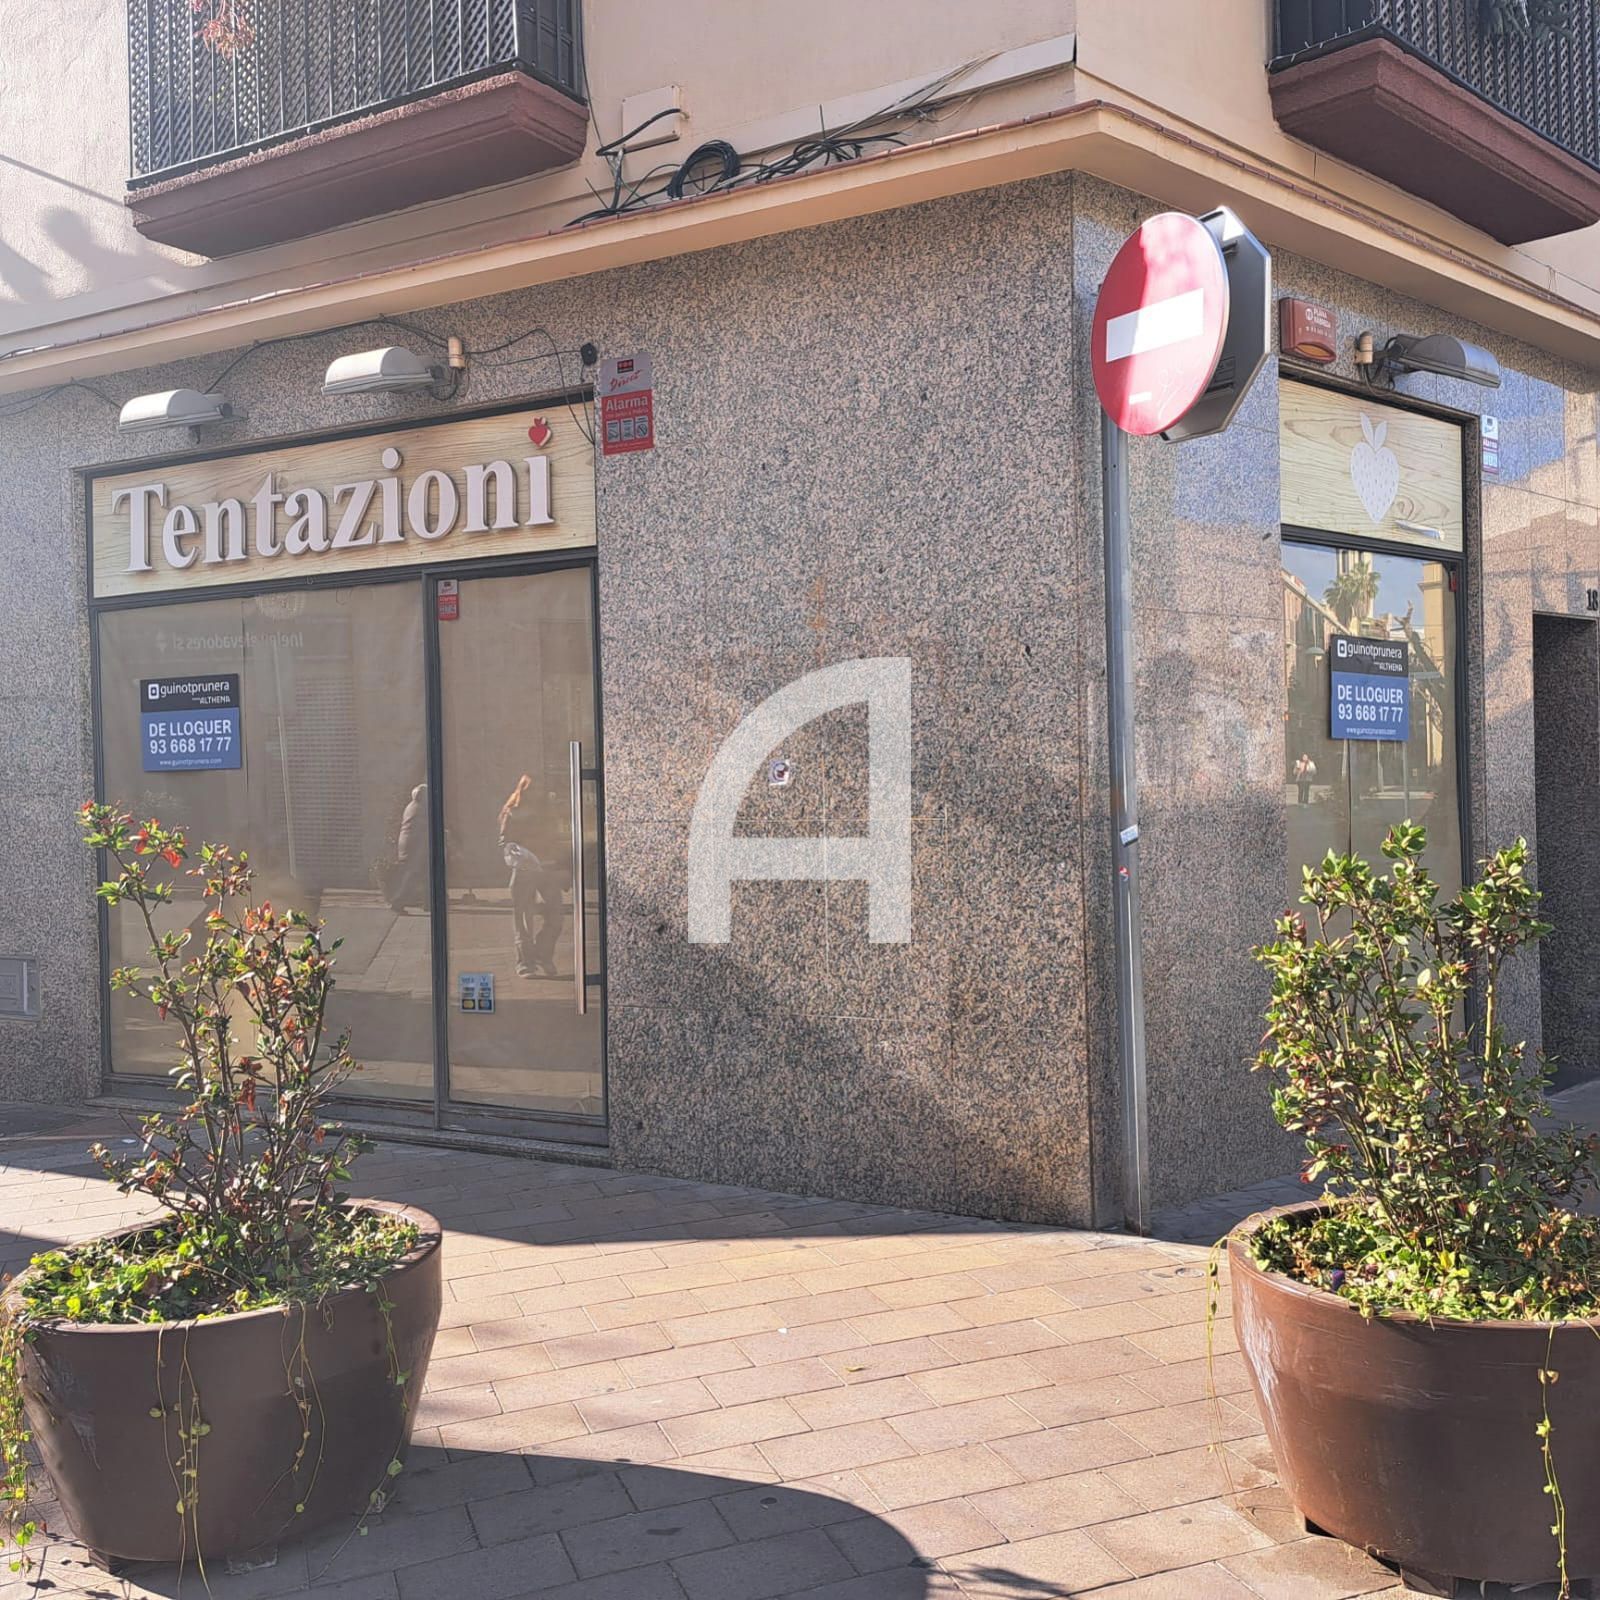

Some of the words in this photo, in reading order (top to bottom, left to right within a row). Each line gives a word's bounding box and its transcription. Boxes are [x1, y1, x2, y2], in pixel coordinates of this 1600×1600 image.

[606, 396, 648, 412] Alarma
[112, 447, 555, 573] Tentazioni
[1586, 588, 1599, 611] 18
[1348, 640, 1402, 660] guinotprunera
[160, 681, 230, 698] guinotprunera
[1337, 684, 1353, 700] DE
[1355, 686, 1403, 704] LLOGUER
[1338, 703, 1353, 720] 93
[1355, 704, 1377, 721] 668
[1379, 706, 1389, 722] 17
[1391, 706, 1403, 723] 77
[149, 722, 167, 737] DE
[169, 719, 232, 736] LLOGUER
[150, 739, 167, 754] 93
[170, 738, 196, 753] 668
[199, 737, 213, 752] 17
[216, 736, 232, 752] 77
